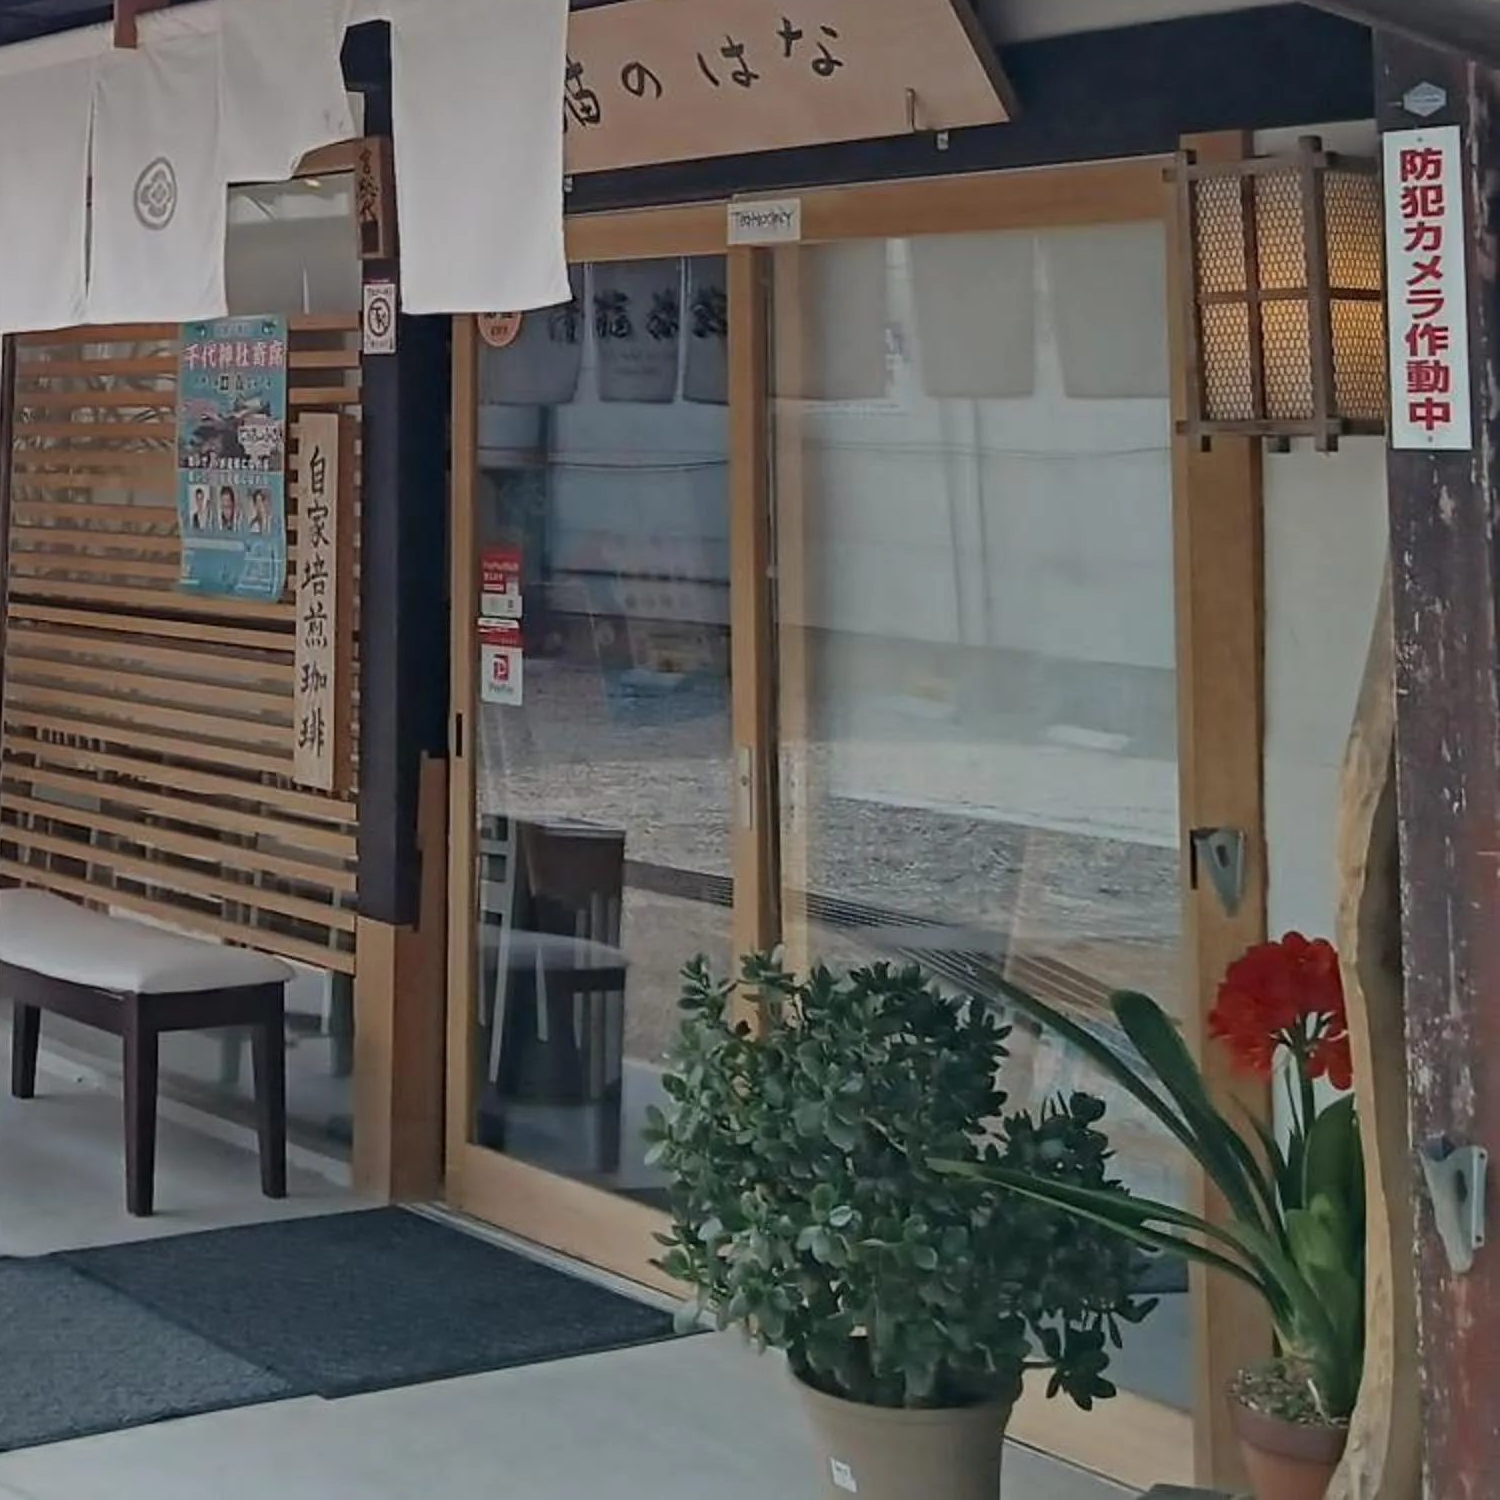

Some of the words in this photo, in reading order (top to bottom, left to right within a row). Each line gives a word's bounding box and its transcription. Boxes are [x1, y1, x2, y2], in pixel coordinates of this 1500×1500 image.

[1398, 148, 1451, 432] 防犯カメラ作動中
